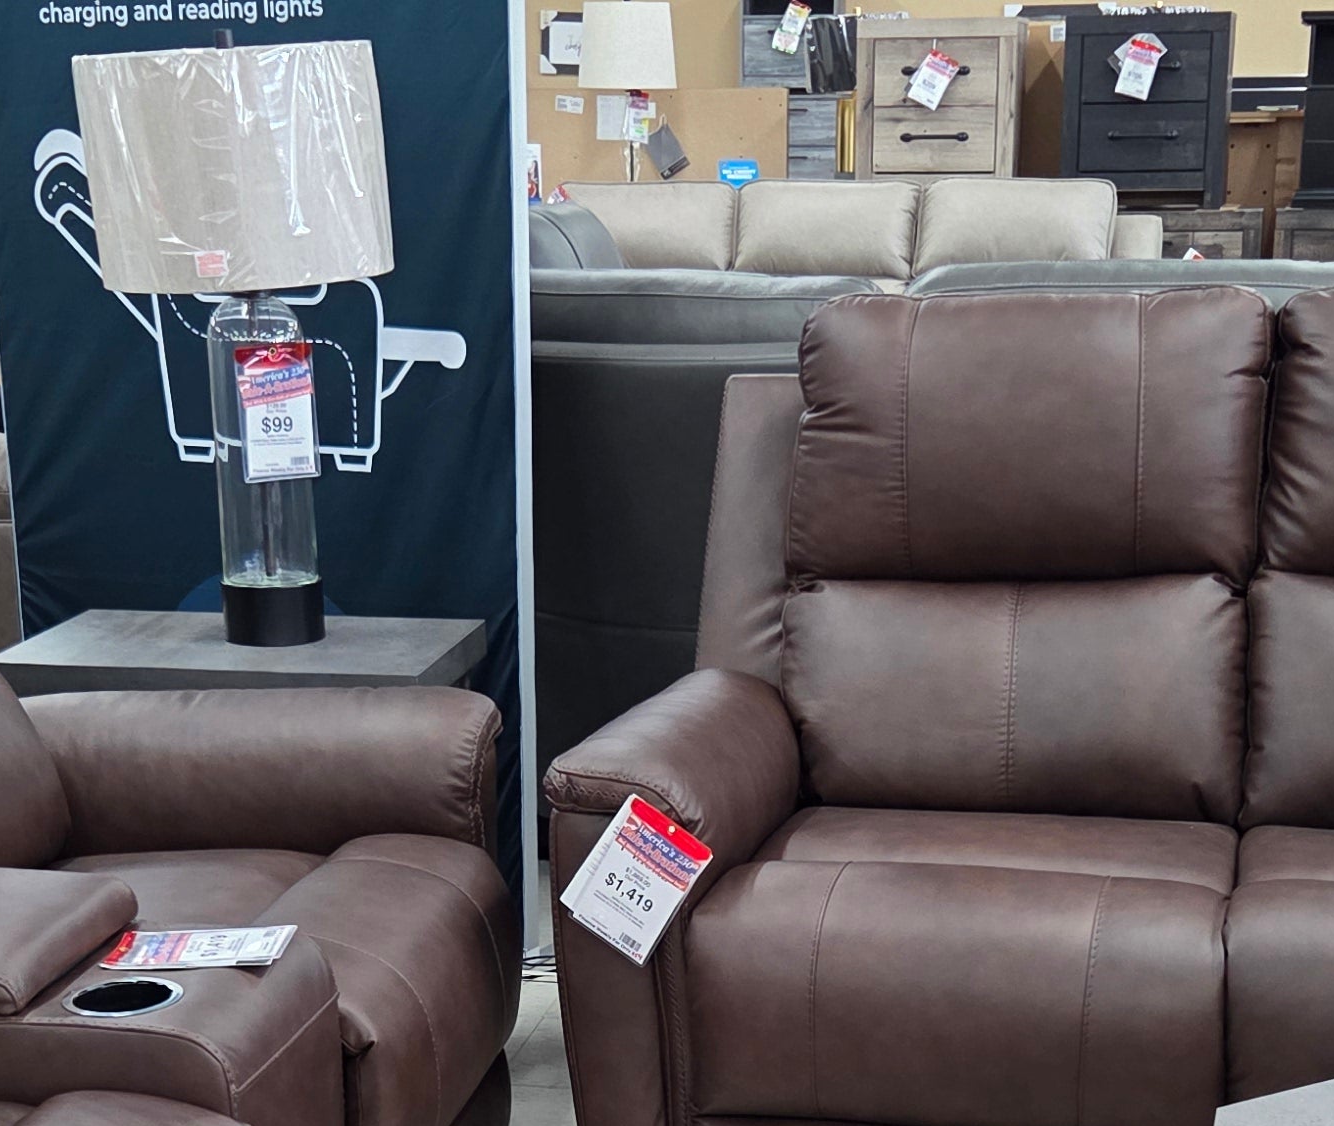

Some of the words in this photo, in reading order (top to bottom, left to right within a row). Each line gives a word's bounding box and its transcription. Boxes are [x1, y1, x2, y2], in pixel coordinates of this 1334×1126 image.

[39, 2, 128, 27] charging
[133, 1, 173, 21] and
[178, 0, 257, 24] reading
[264, 0, 324, 22] lights
[261, 416, 293, 434] $99
[638, 823, 675, 858] America's
[604, 872, 653, 912] $1,419
